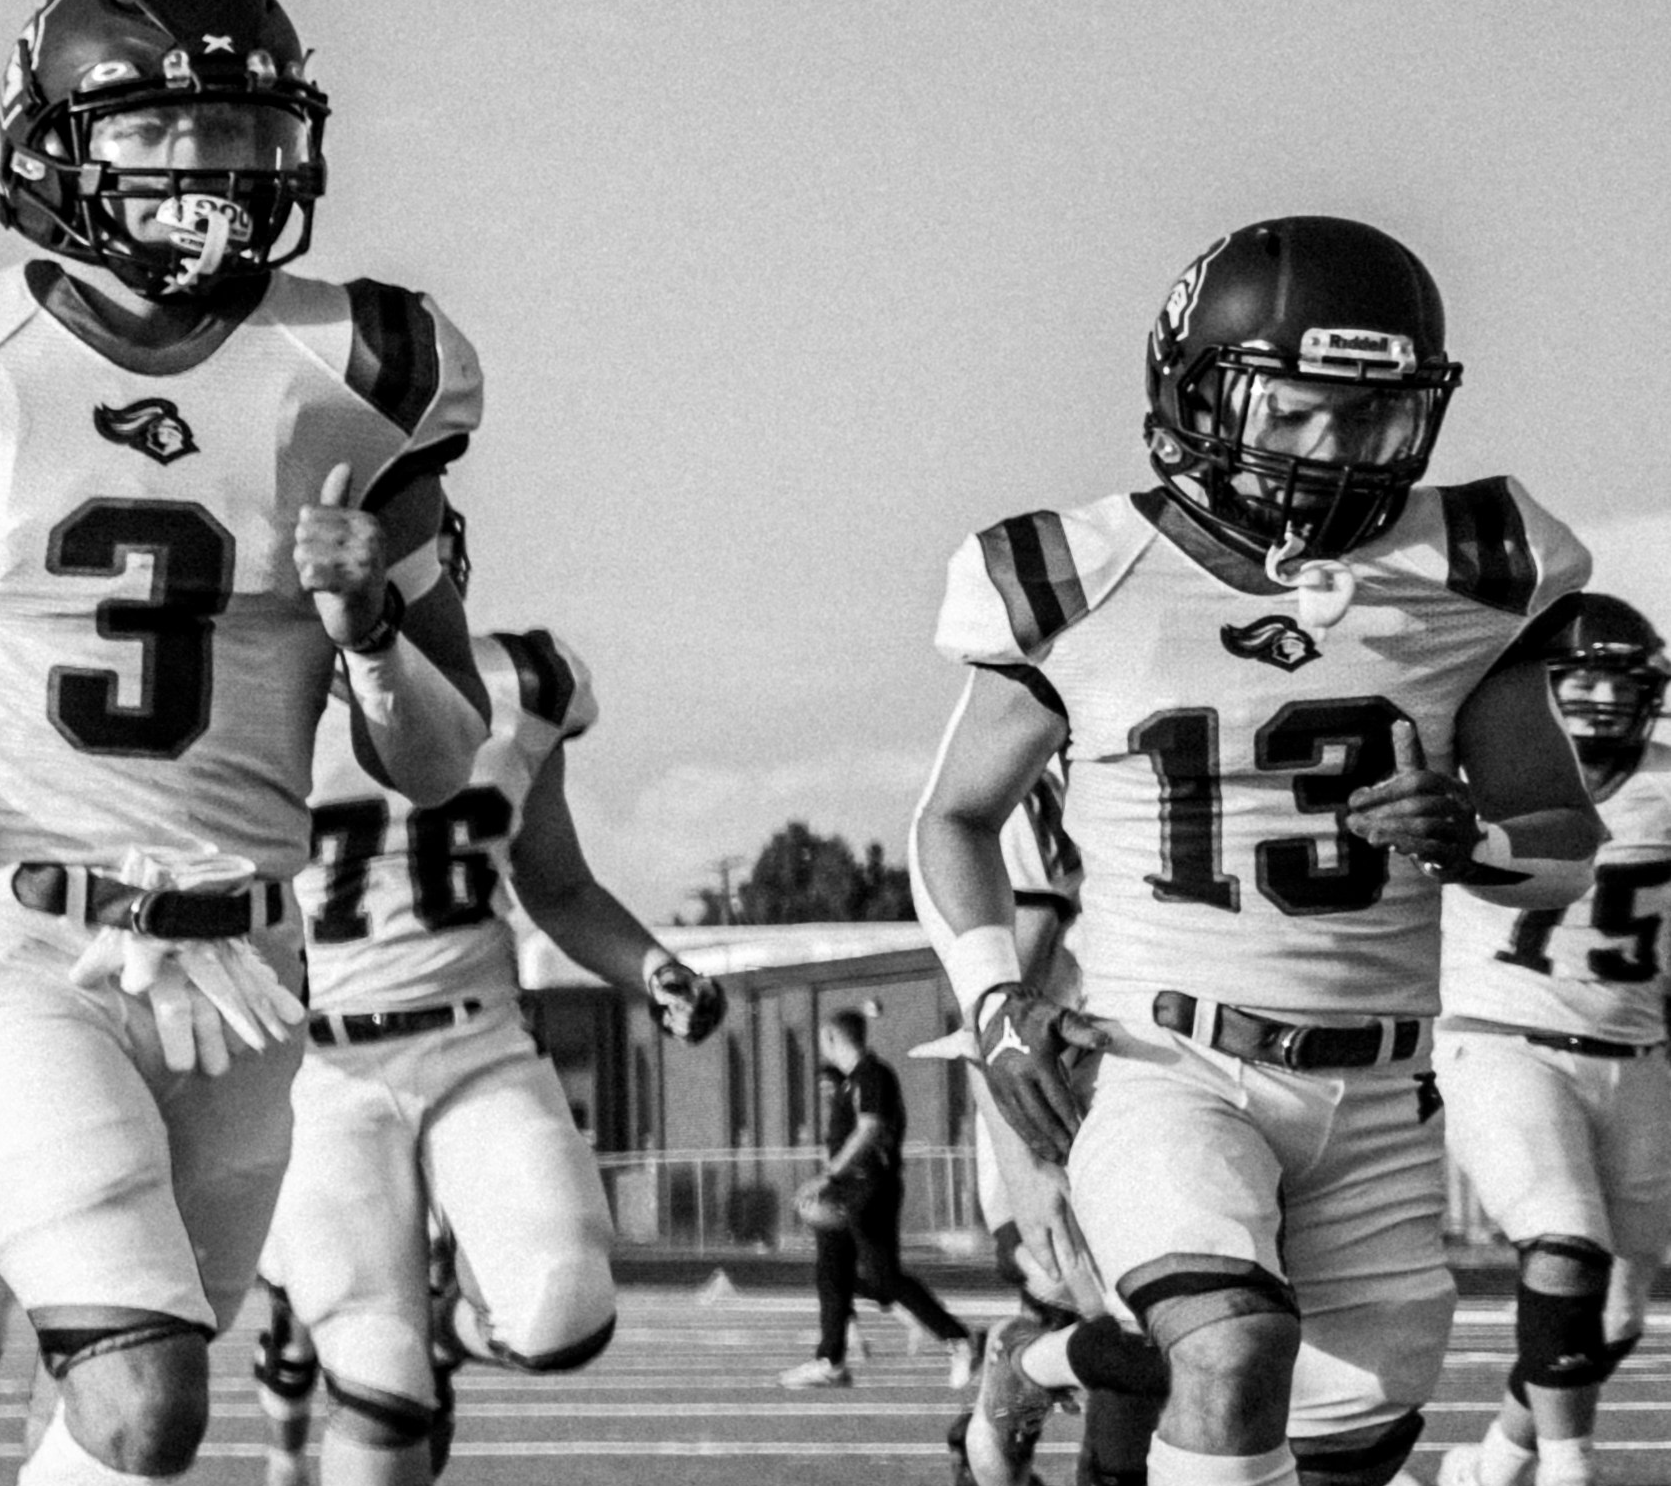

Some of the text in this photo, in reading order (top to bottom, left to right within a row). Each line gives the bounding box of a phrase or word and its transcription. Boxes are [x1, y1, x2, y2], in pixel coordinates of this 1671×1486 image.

[45, 497, 236, 761] 3
[309, 785, 513, 945] 76
[1128, 695, 1418, 916] 13
